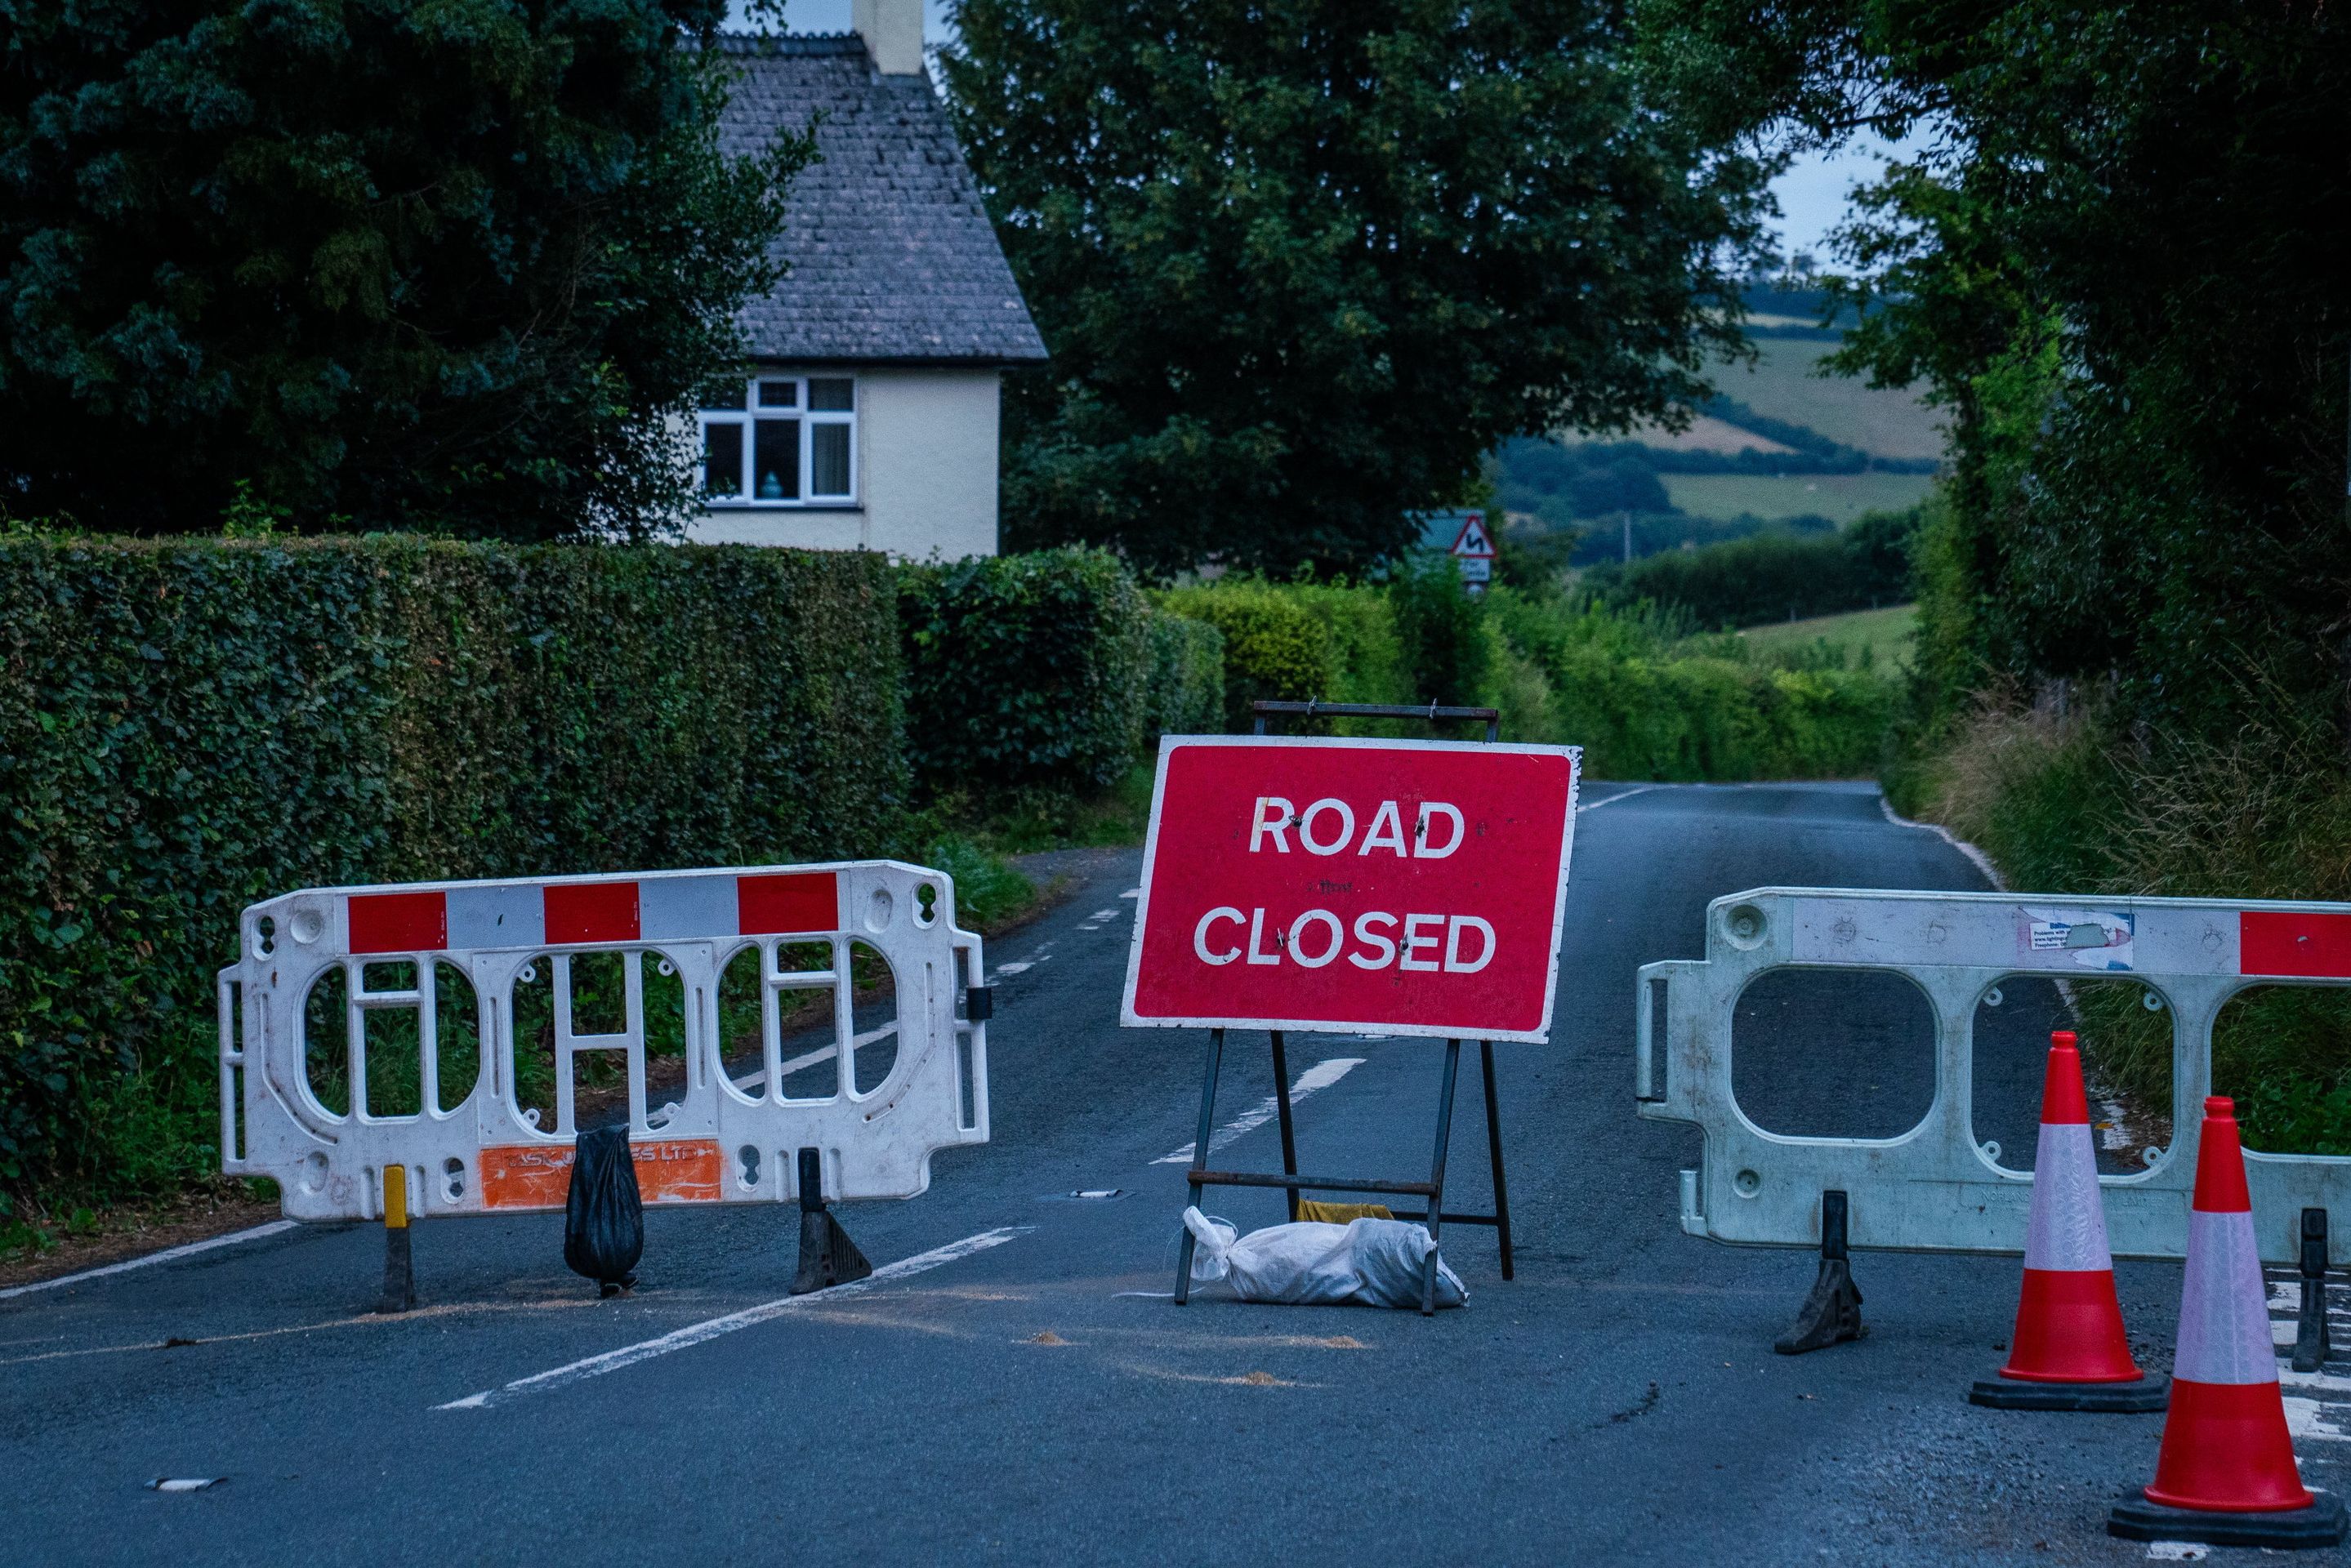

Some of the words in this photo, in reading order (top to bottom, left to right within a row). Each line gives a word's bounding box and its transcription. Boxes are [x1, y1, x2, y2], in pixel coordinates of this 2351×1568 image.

[1249, 796, 1465, 859] ROAD
[1193, 906, 1497, 973] CLOSED
[660, 1146, 695, 1161] LTD
